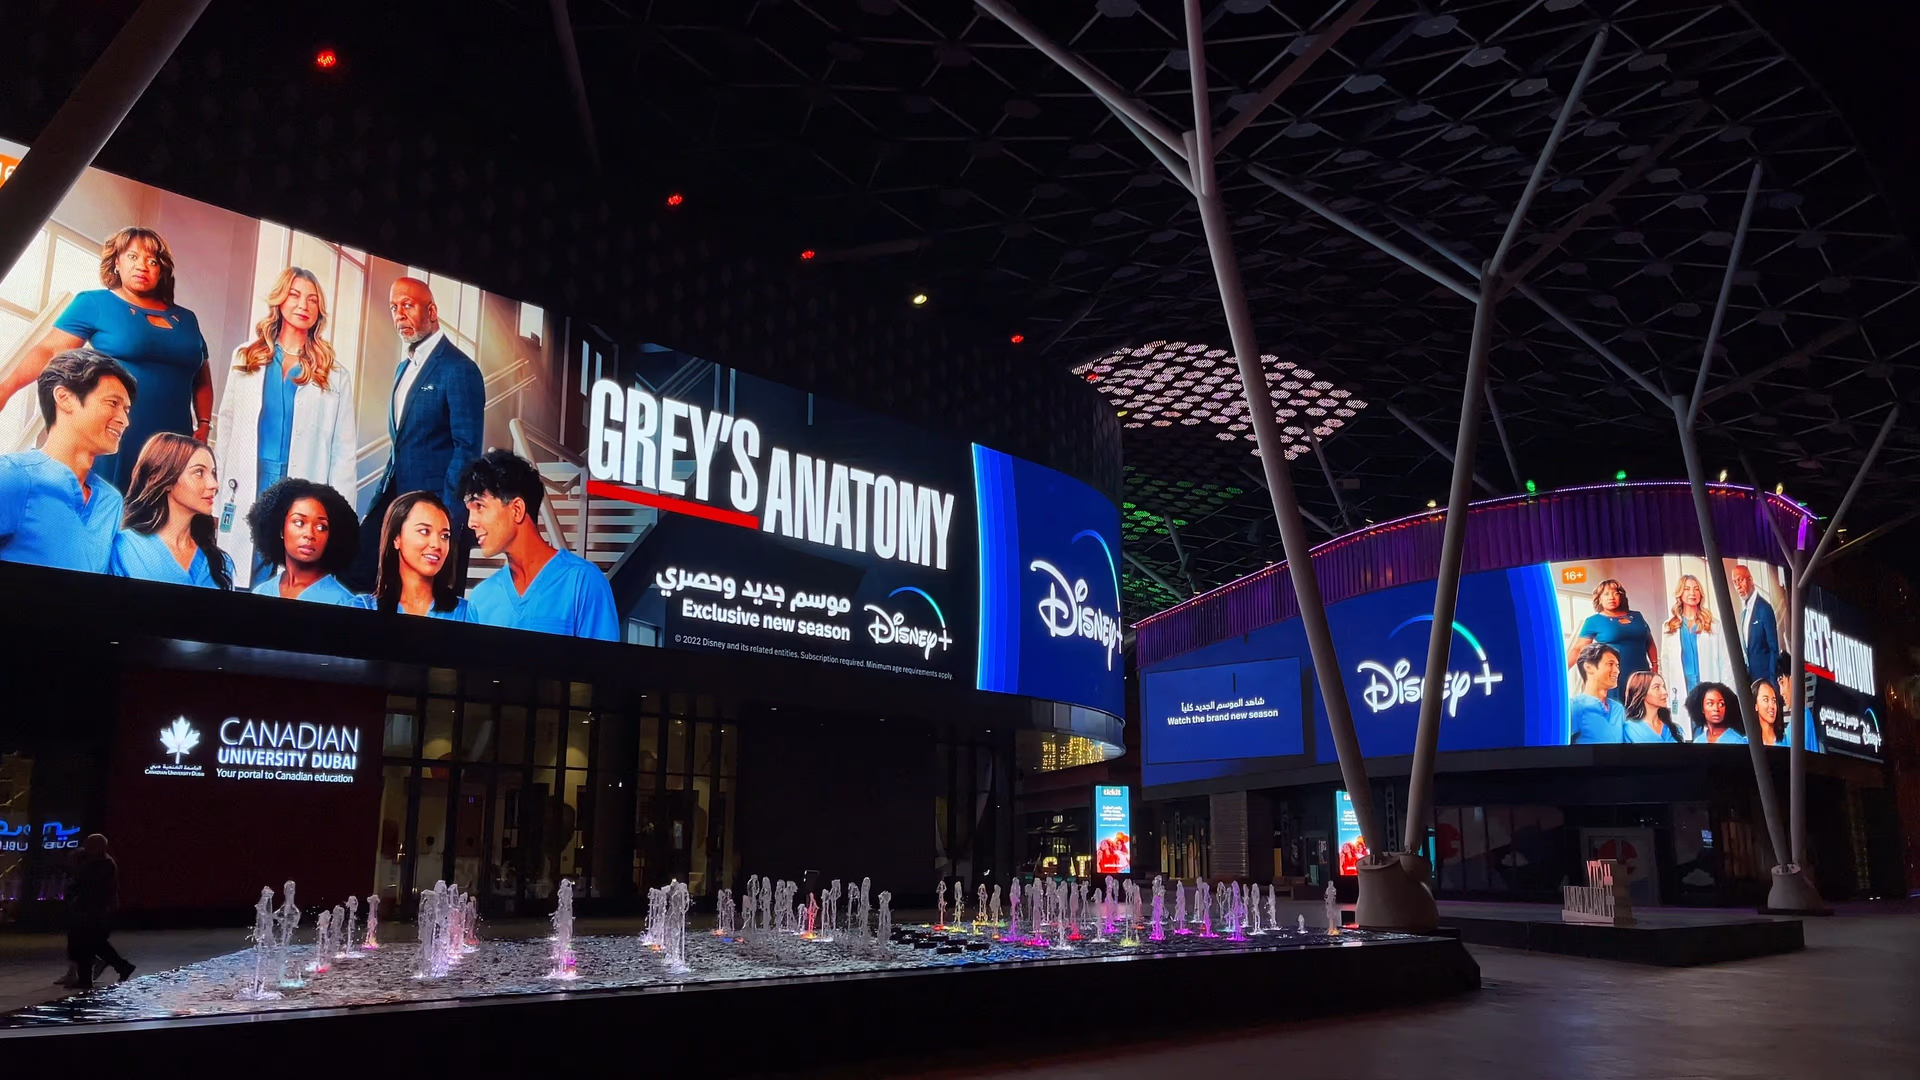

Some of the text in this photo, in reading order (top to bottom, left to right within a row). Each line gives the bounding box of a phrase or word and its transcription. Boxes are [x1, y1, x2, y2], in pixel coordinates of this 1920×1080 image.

[588, 379, 954, 570] GREY'S ANATOMY
[655, 566, 851, 616] موسم جديد وحصري
[1564, 571, 1583, 581] 16+
[682, 599, 851, 641] Exclusive new season
[864, 604, 953, 660] Disney+
[1030, 560, 1122, 671] Disney+
[683, 635, 701, 645] 2022
[702, 638, 726, 650] Disney
[726, 642, 740, 651] and
[740, 643, 749, 652] its
[750, 645, 773, 655] related
[774, 648, 800, 659] entities.
[800, 651, 839, 663] Subscription
[839, 658, 865, 668] required.
[866, 660, 892, 671] Minimum
[892, 664, 902, 673] age
[902, 666, 938, 677] requirements
[938, 671, 953, 680] apply.
[1804, 607, 1876, 697] REY'S ANATOMY
[1194, 701, 1215, 712] الجديد
[1216, 698, 1244, 711] الموسم
[1244, 697, 1265, 707] شاهد
[1357, 658, 1503, 717] Disey+
[220, 717, 359, 752] CANADIAN
[1167, 708, 1279, 726] Watch the brand new season
[216, 768, 354, 783] Your portal to Canadian education
[217, 747, 357, 770] UNIVERSITY DUBAI
